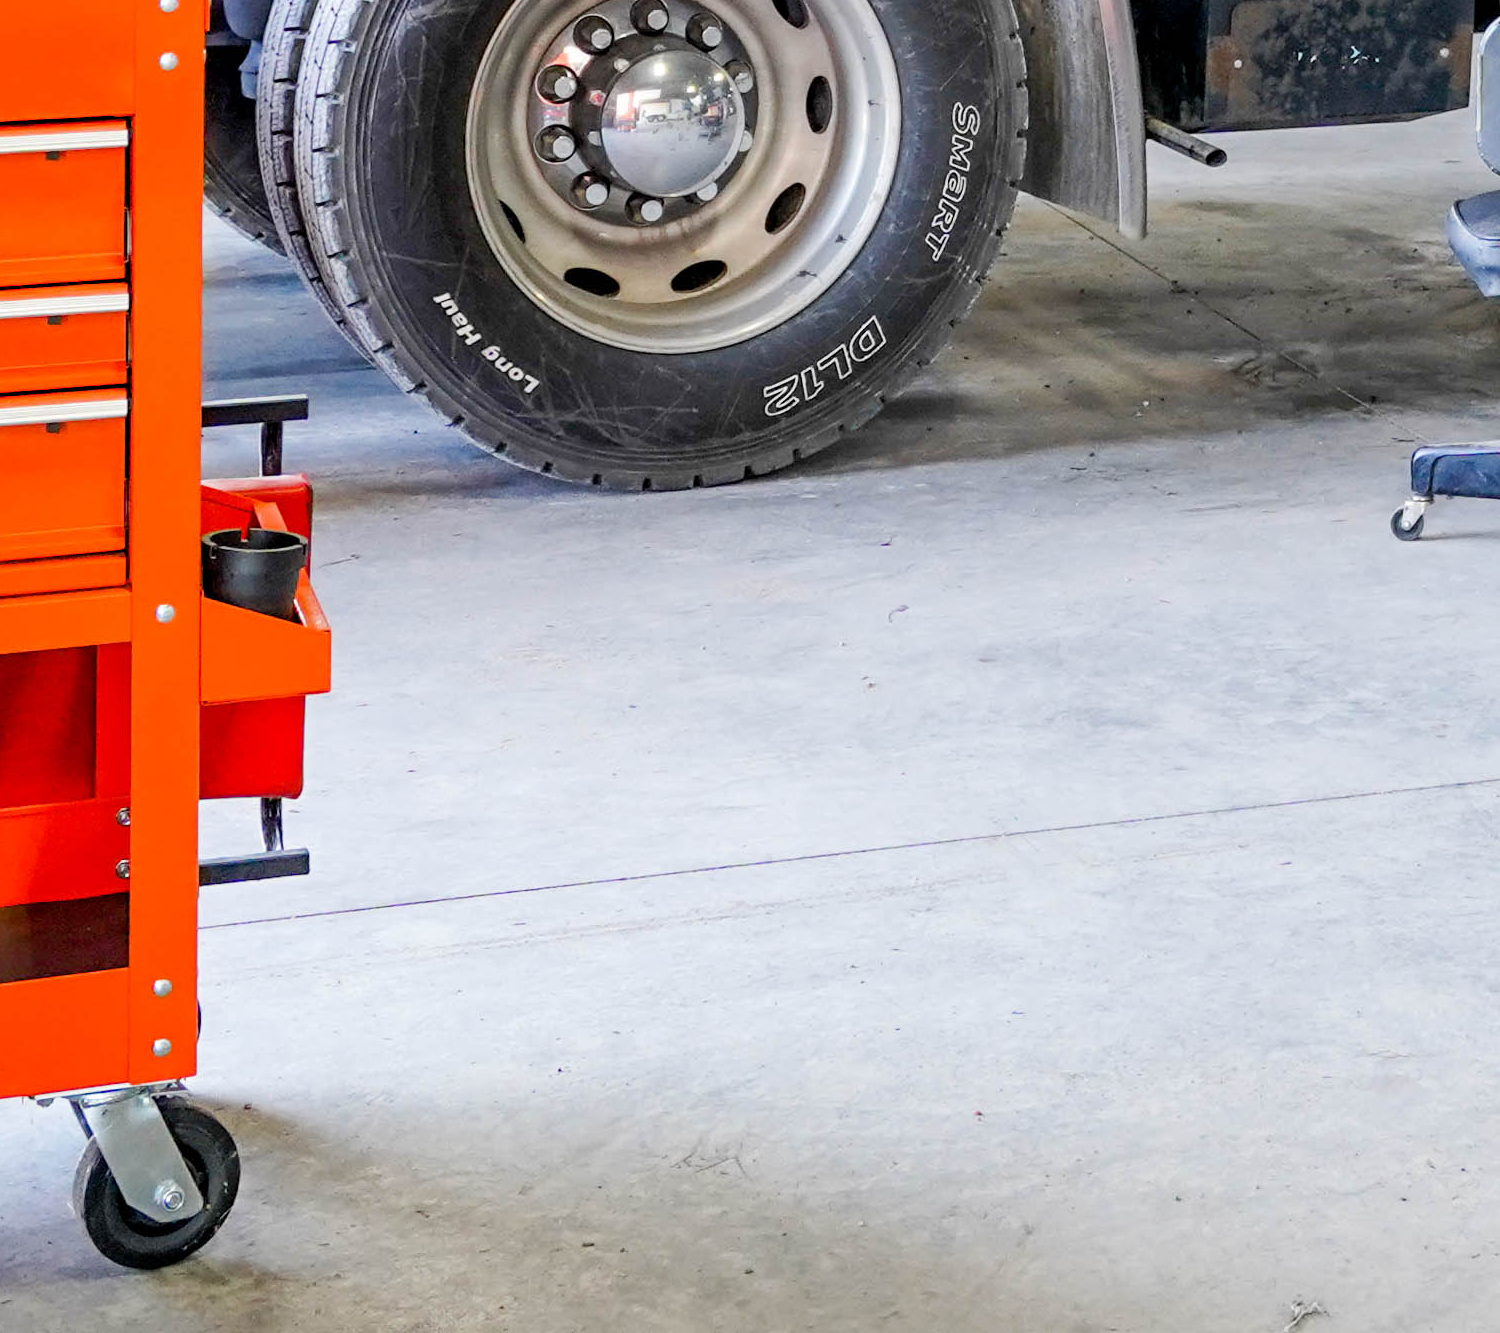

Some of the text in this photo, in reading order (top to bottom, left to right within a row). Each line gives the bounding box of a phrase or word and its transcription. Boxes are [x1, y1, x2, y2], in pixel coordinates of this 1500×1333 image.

[432, 292, 540, 394] Long Haul
[762, 315, 888, 417] DL12
